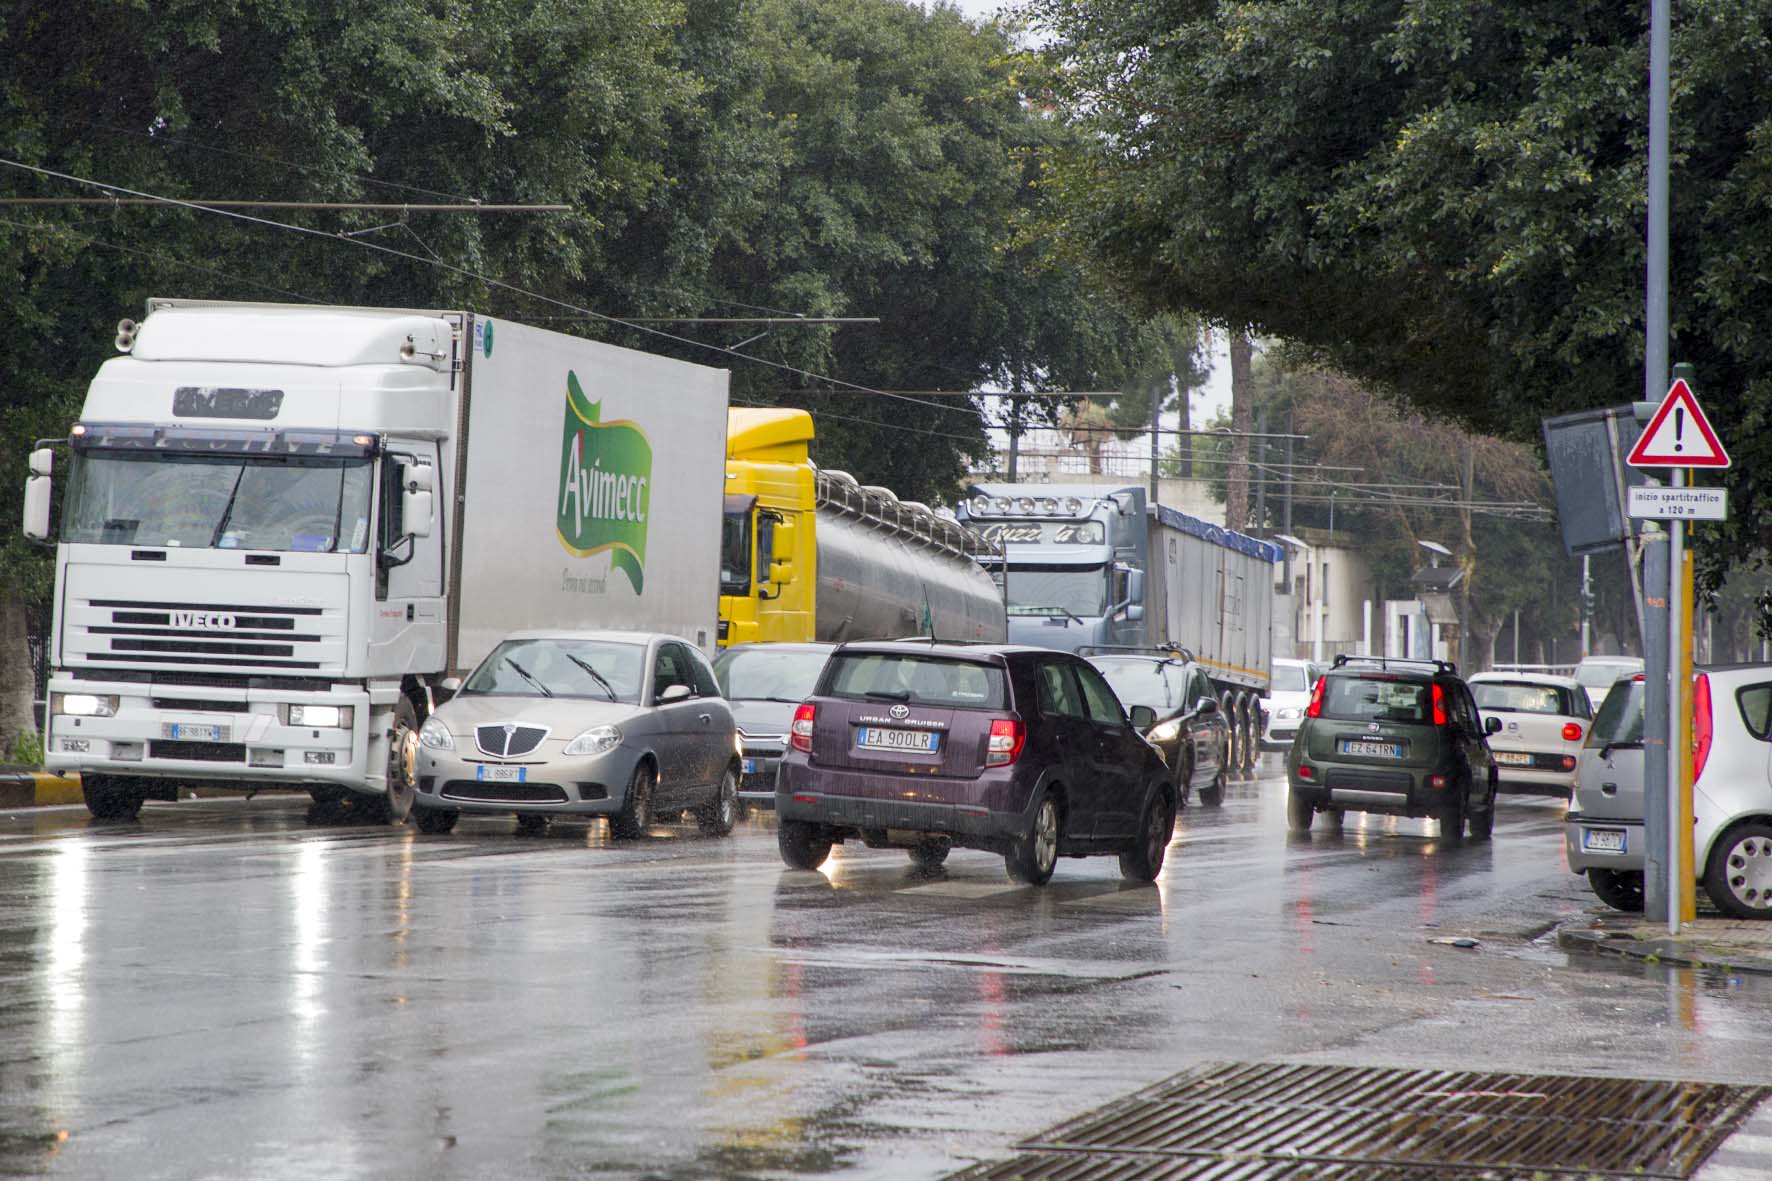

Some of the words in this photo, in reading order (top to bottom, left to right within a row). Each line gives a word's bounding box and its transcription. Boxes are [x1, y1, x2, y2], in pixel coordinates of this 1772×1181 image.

[562, 429, 647, 539] Avimecc
[1635, 491, 1658, 501] inizio
[1662, 492, 1720, 503] spartitraffico
[1668, 506, 1684, 514] 120
[169, 610, 236, 629] IVECO
[859, 715, 891, 724] URBAN
[904, 719, 945, 728] CRUISER
[867, 729, 883, 745] EA
[888, 731, 929, 748] 900LR
[1352, 742, 1362, 753] EZ
[1366, 743, 1395, 755] 641RN
